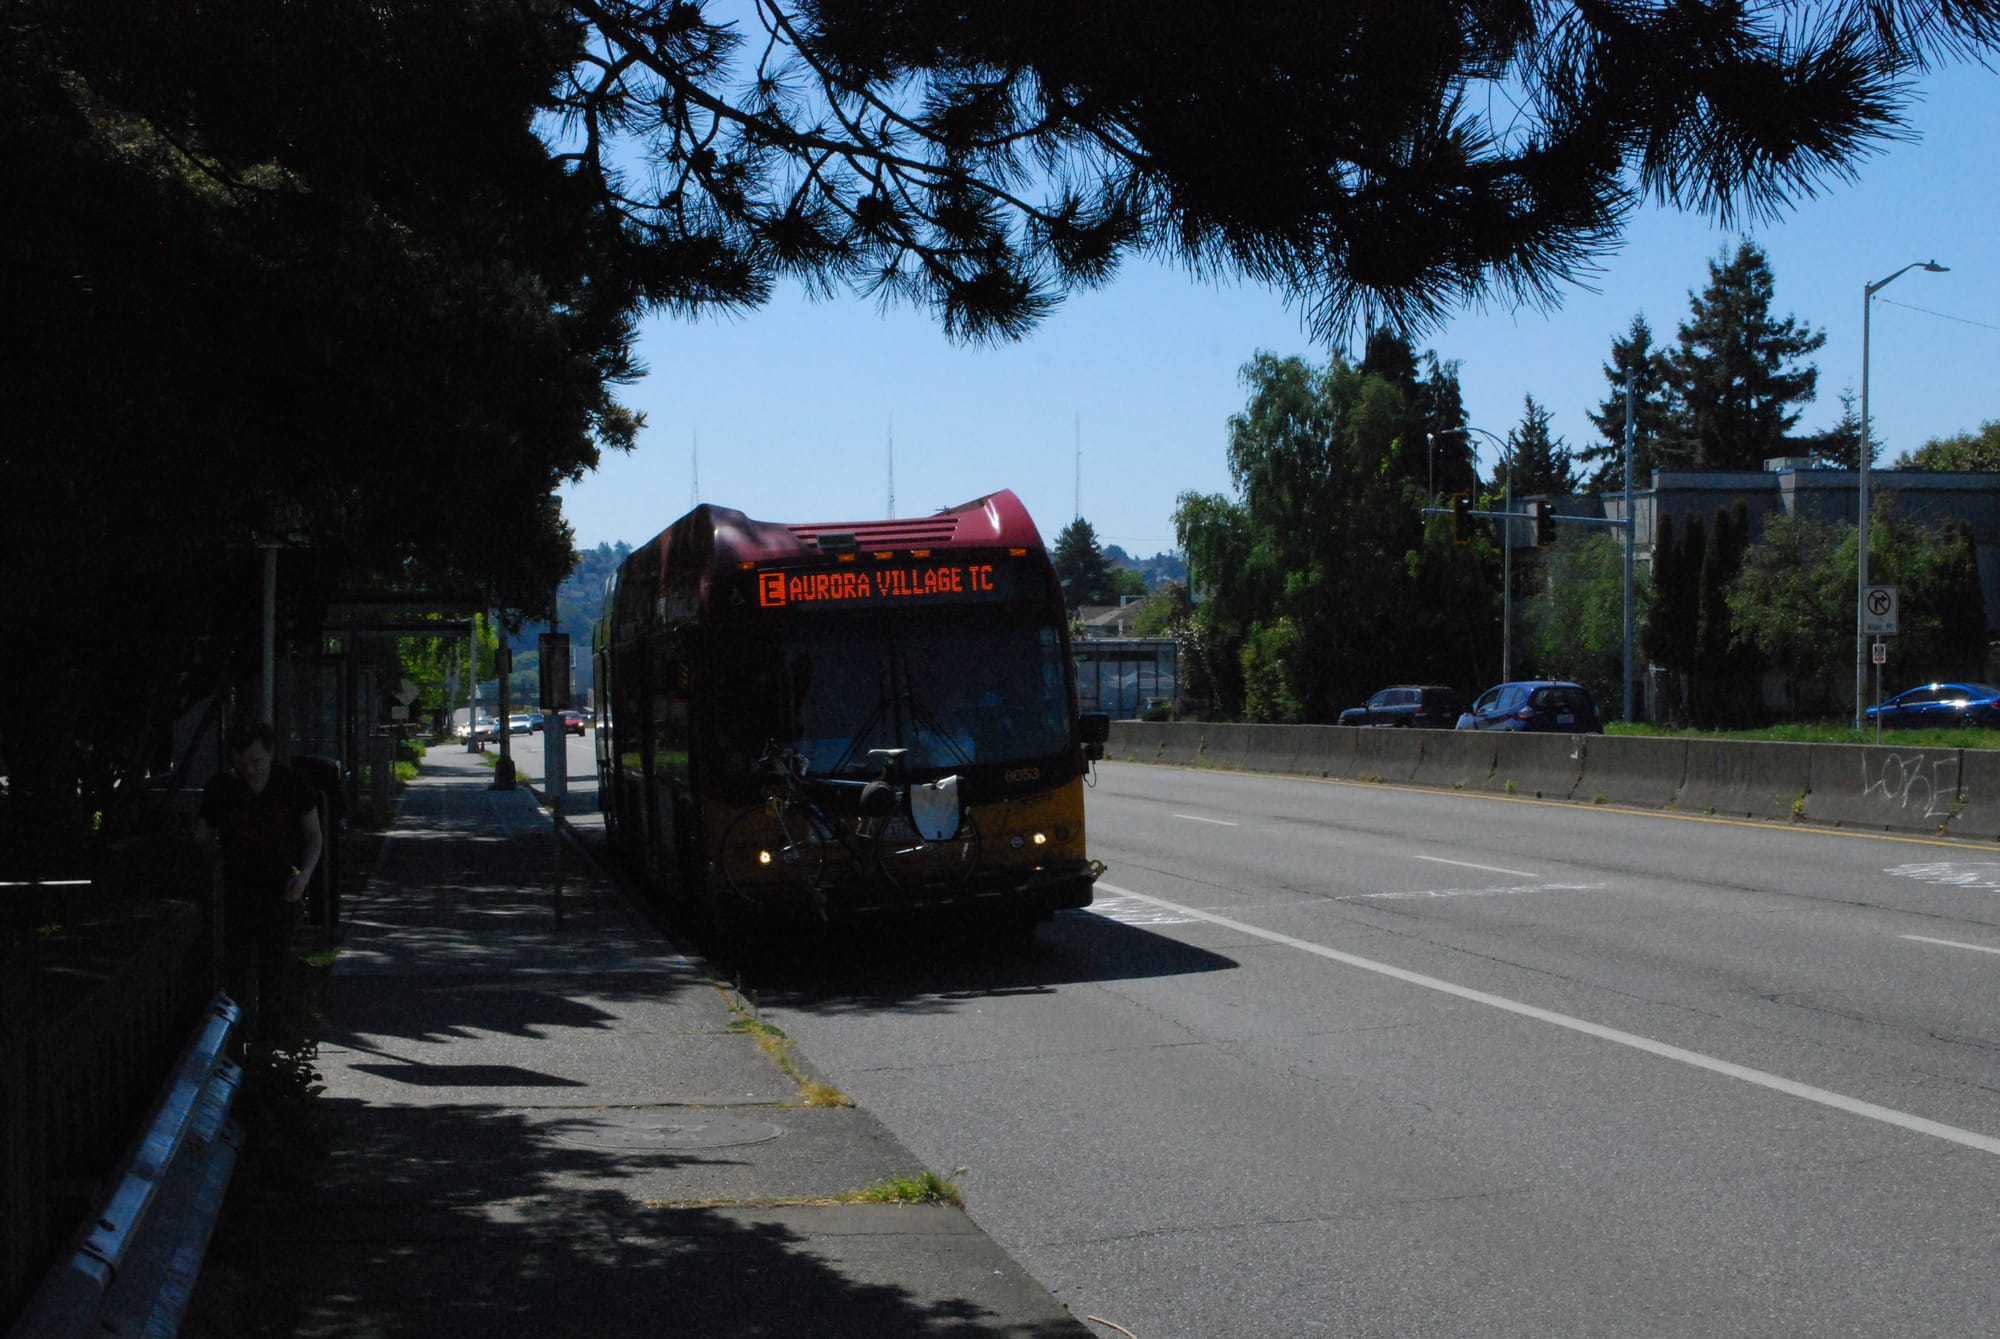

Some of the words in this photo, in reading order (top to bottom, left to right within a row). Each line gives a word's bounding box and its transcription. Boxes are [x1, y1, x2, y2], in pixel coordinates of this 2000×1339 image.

[761, 573, 785, 606] E
[789, 573, 871, 601] AURORA
[876, 568, 962, 597] VILLAGE
[969, 565, 993, 592] TC
